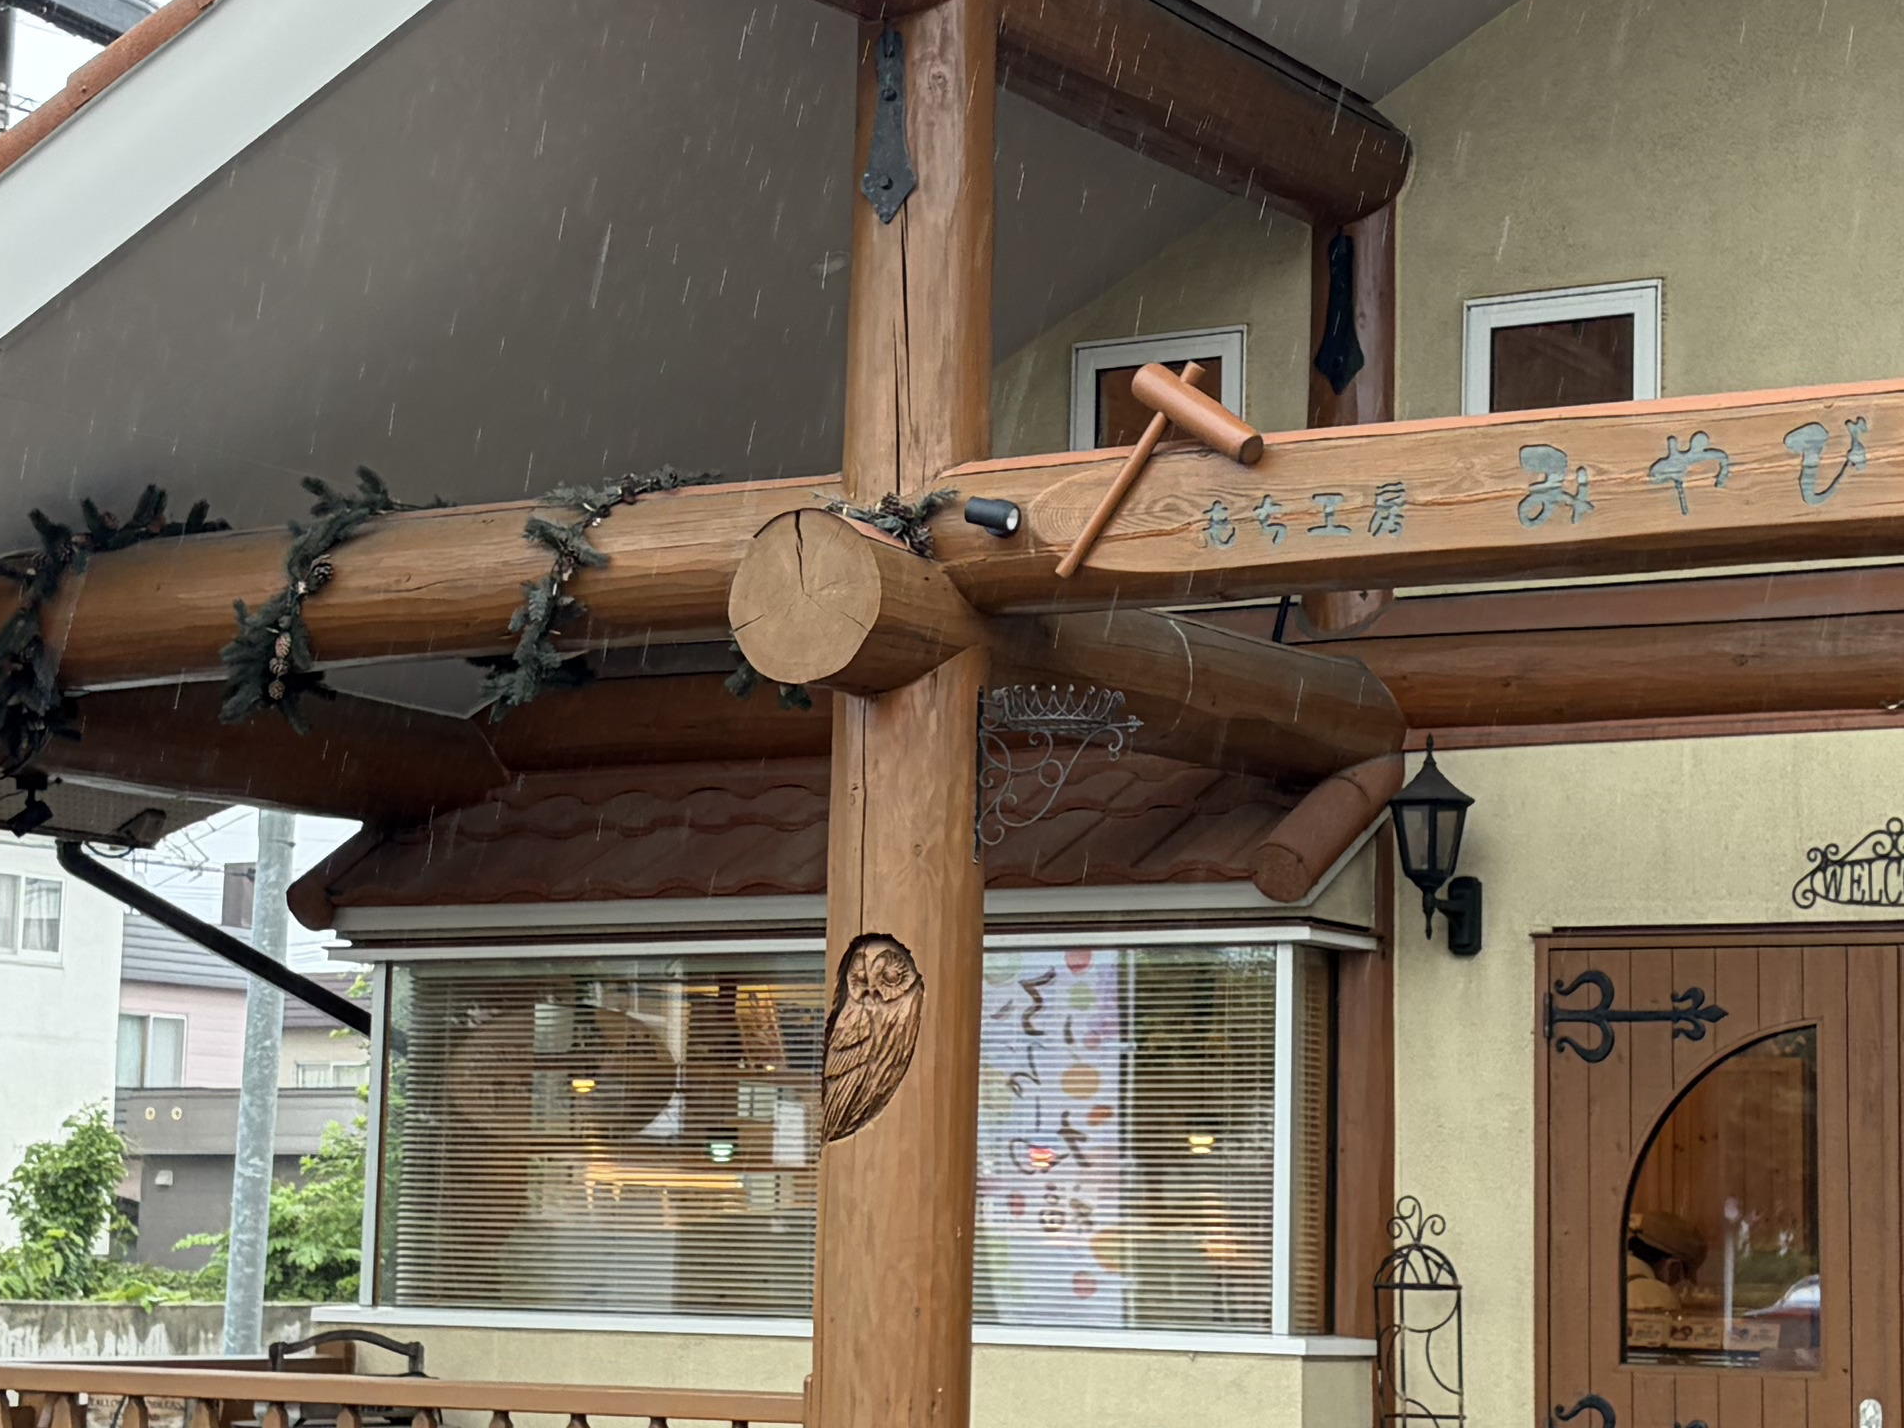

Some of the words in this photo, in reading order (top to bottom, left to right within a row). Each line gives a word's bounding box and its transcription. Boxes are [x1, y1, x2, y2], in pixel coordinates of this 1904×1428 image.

[1202, 481, 1407, 549] もち工房
[1517, 416, 1869, 528] みやび
